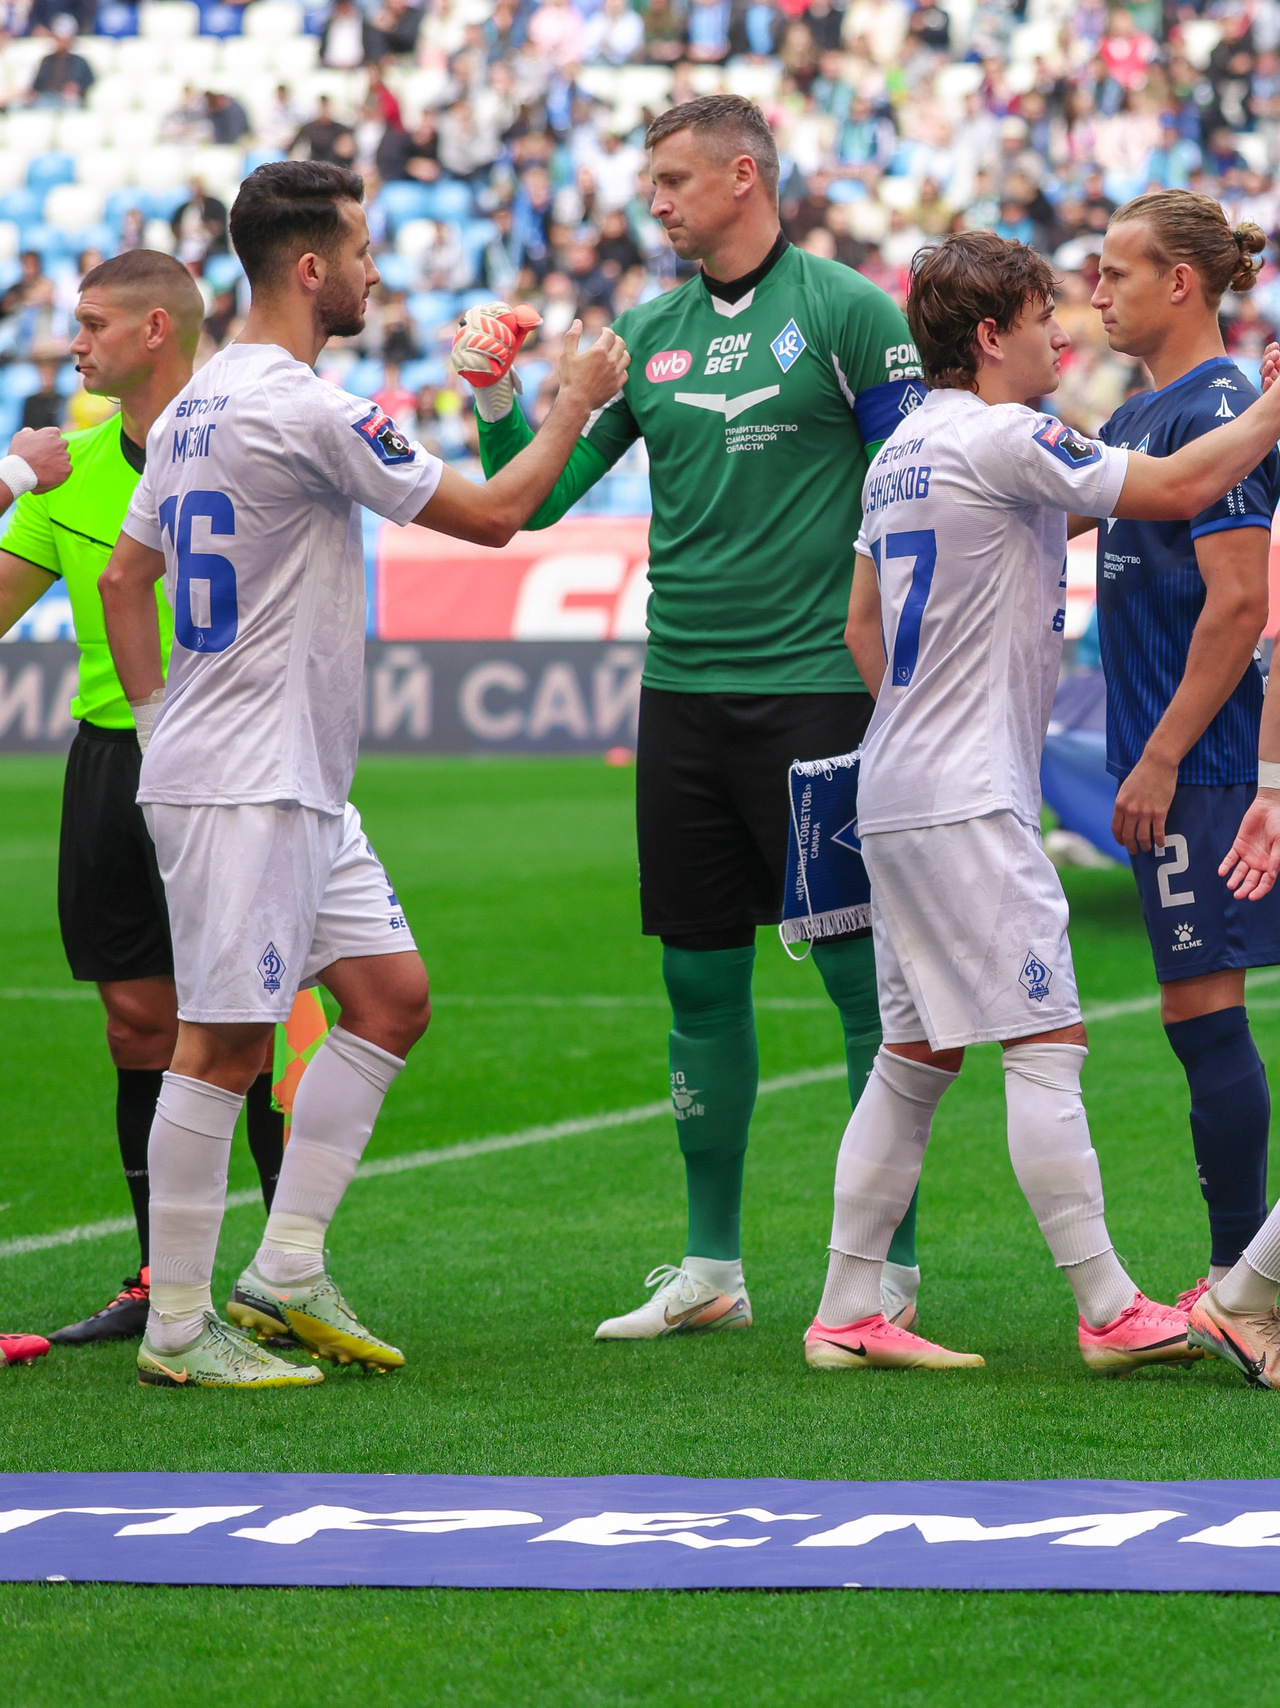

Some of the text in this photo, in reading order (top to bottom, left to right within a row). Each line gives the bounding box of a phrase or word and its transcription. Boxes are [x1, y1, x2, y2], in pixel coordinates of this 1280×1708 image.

[706, 332, 752, 356] FON
[652, 353, 686, 377] wb
[704, 352, 749, 376] BET
[725, 424, 798, 436] ПРАВИТЕЛЬСТВО
[726, 433, 777, 445] САМАРСКОЙ
[159, 490, 238, 653] 16
[870, 529, 938, 687] 7
[800, 783, 812, 845] СОВЕТОВ»
[811, 822, 821, 859] САМАРА
[1155, 834, 1196, 908] 2
[1171, 939, 1203, 952] KELME
[674, 1103, 705, 1121] ELME
